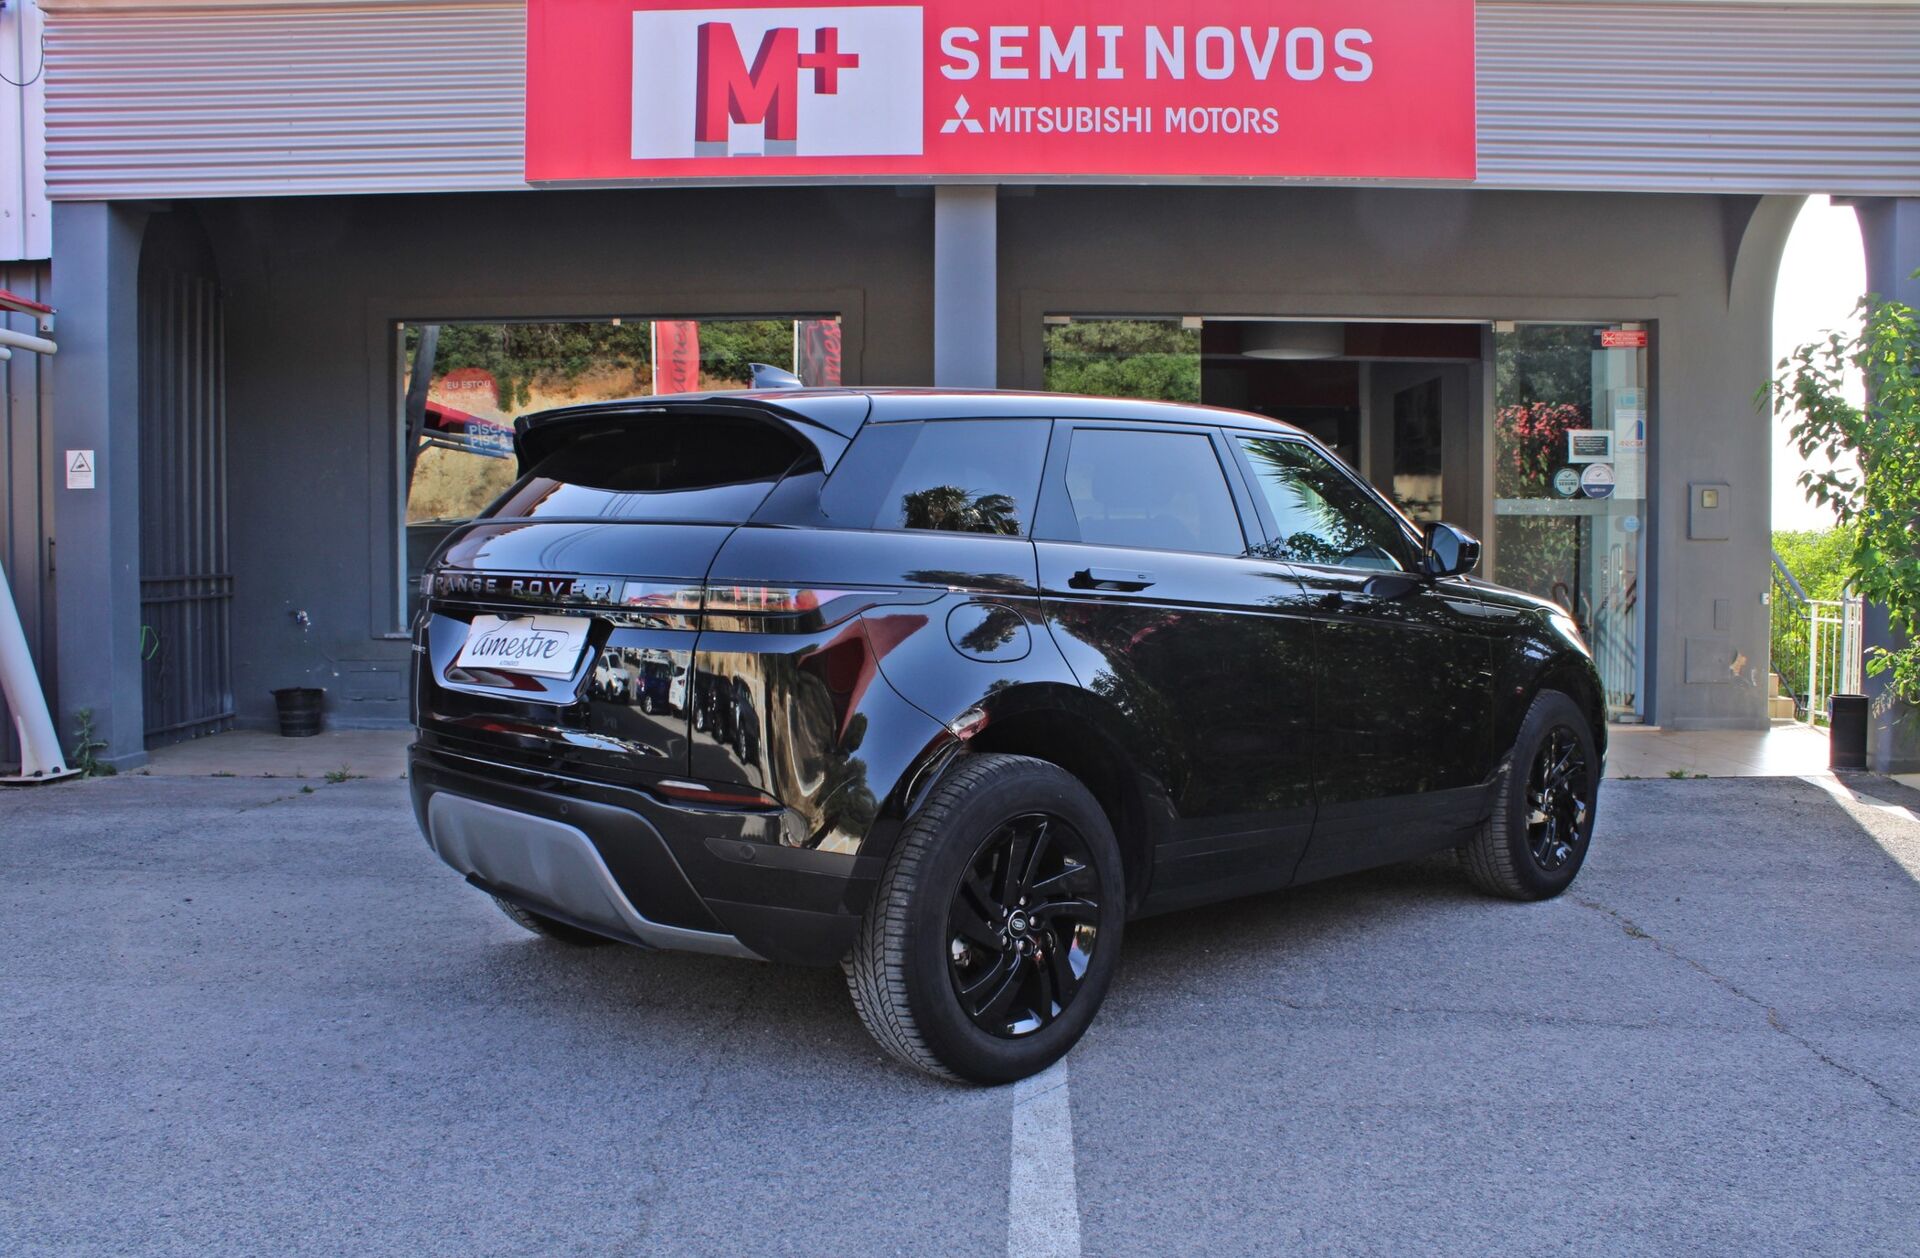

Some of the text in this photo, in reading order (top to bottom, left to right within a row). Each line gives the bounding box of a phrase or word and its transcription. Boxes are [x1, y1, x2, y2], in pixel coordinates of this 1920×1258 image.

[939, 25, 1374, 82] SEMI NOVOS
[989, 106, 1279, 134] MITSUBISHI MOTORS
[461, 380, 491, 390] ESTOU
[435, 576, 613, 600] RANGE ROVER
